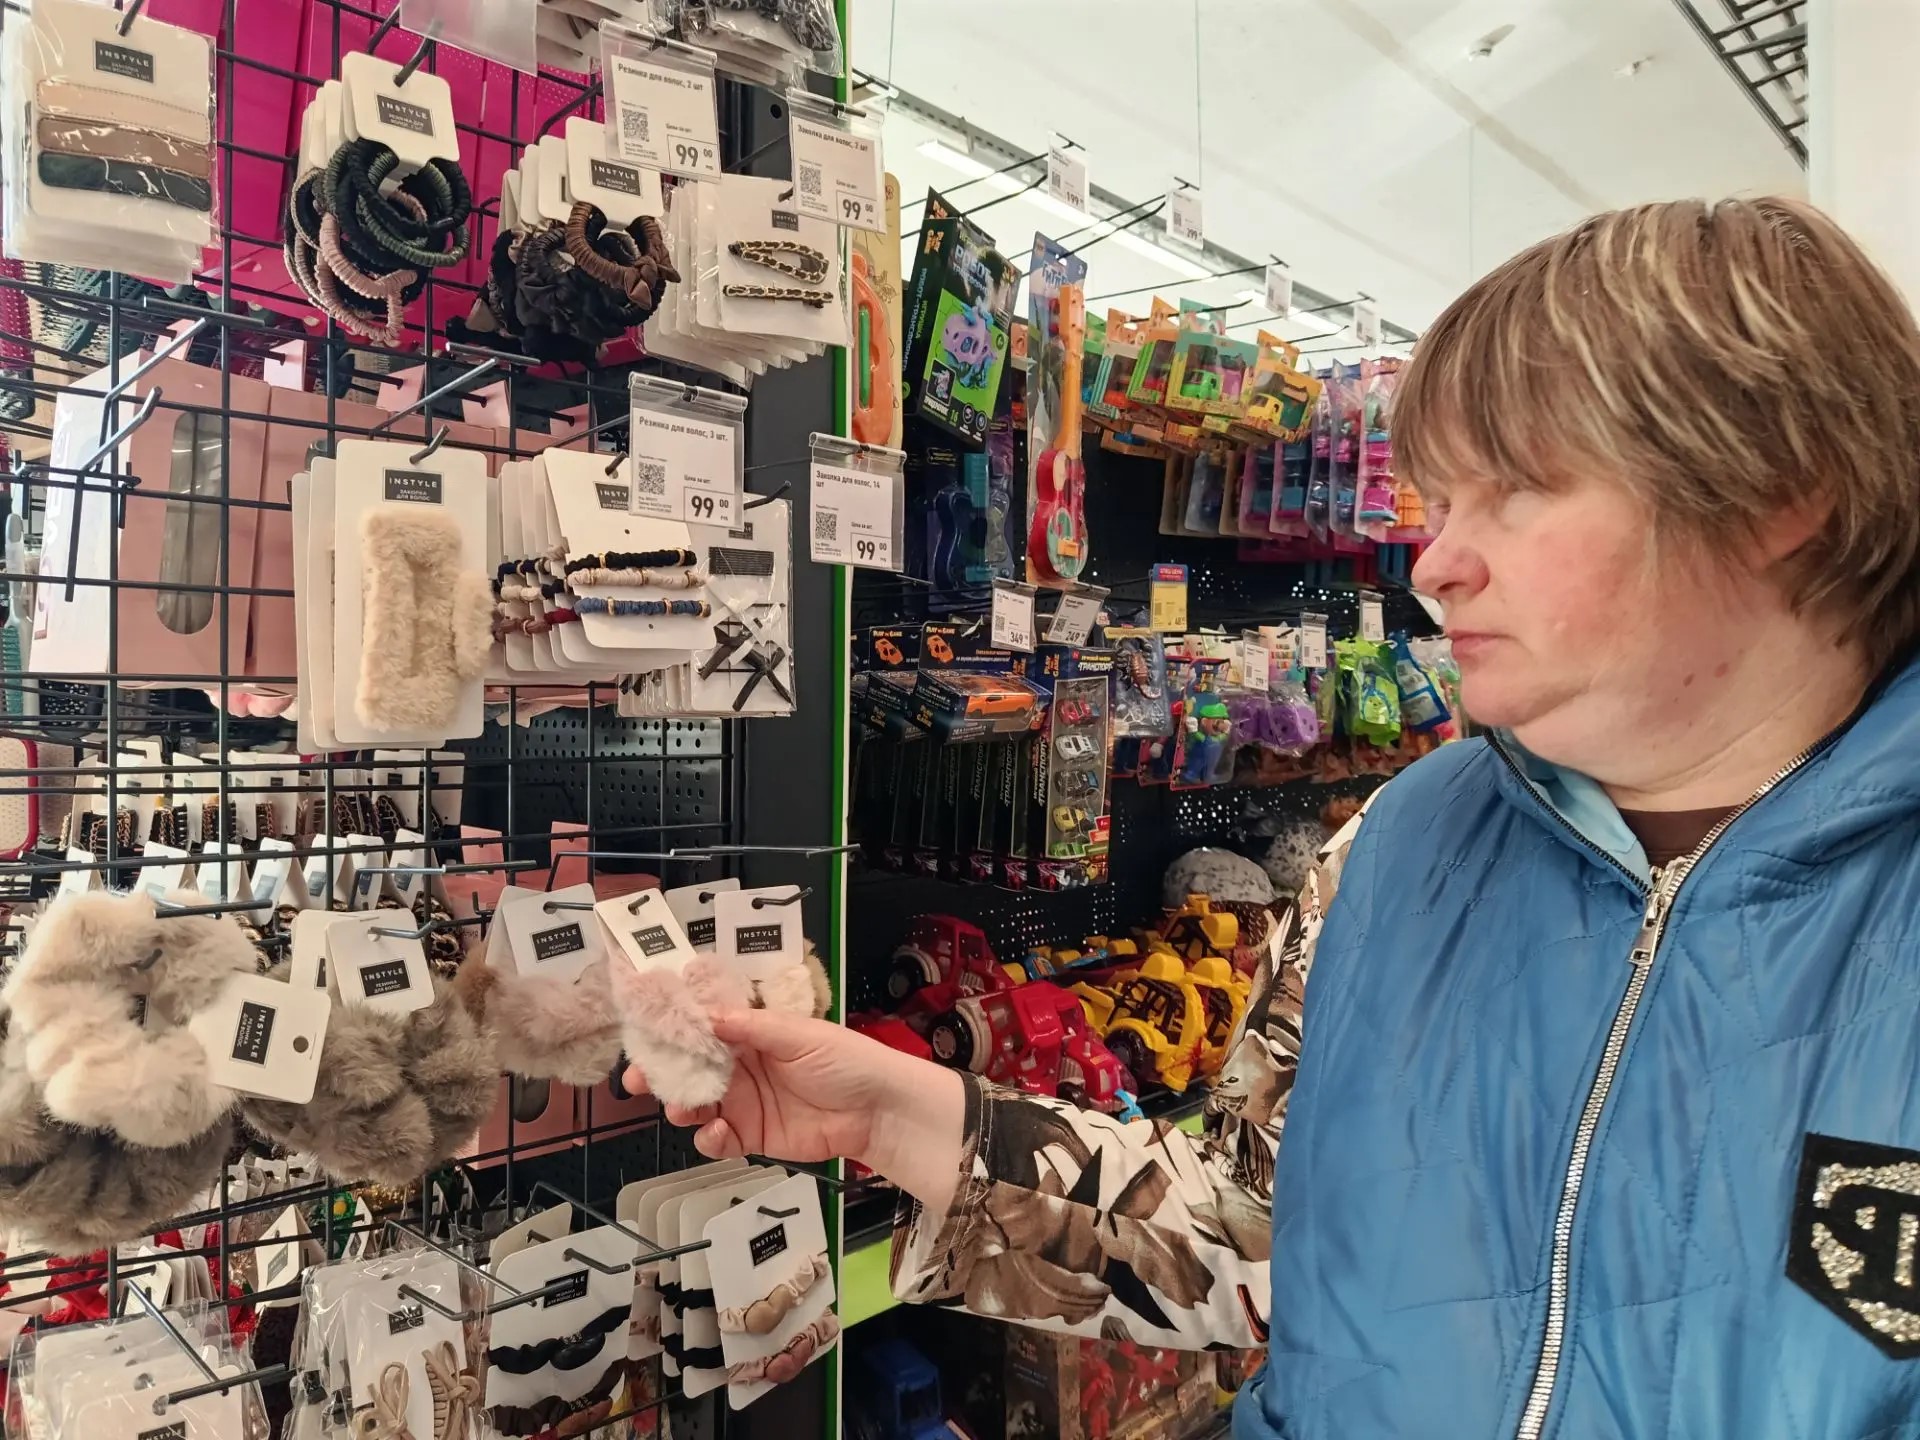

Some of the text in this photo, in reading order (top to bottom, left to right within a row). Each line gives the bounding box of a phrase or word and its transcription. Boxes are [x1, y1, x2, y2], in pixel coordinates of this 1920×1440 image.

[99, 49, 149, 67] INSTYLE
[618, 63, 703, 91] Резинка для волос, 2 шт
[381, 101, 428, 120] INSTYLE
[798, 124, 823, 139] Заколка
[823, 133, 835, 141] для
[835, 137, 853, 149] волос,
[676, 143, 698, 167] 99
[703, 148, 713, 158] 00
[594, 165, 636, 180] INSTYLE
[842, 199, 861, 220] 99
[864, 203, 874, 213] 00
[954, 244, 993, 283] РОБОТ
[639, 416, 669, 430] Резинка
[671, 424, 684, 433] для
[686, 427, 708, 439] волос,
[716, 433, 728, 441] шт.
[389, 476, 438, 488] INSTYLE
[816, 470, 880, 489] Заколка для волос, 14
[599, 489, 628, 498] INSTY
[691, 495, 714, 518] 99
[719, 499, 729, 509] 00
[856, 540, 876, 560] 99
[879, 543, 888, 551] 00
[1010, 631, 1023, 644] 349
[536, 928, 577, 944] INSTYLE
[636, 929, 666, 943] INSTYLE
[690, 922, 714, 932] INSTY
[739, 930, 779, 939] INSTYLE
[364, 967, 404, 981] INSTYLE
[375, 979, 397, 988] РЕЗИНКА
[243, 1017, 254, 1046] РЕЗИНКА
[250, 1009, 267, 1058] INSTYLE
[752, 1229, 782, 1251] INSTYLE
